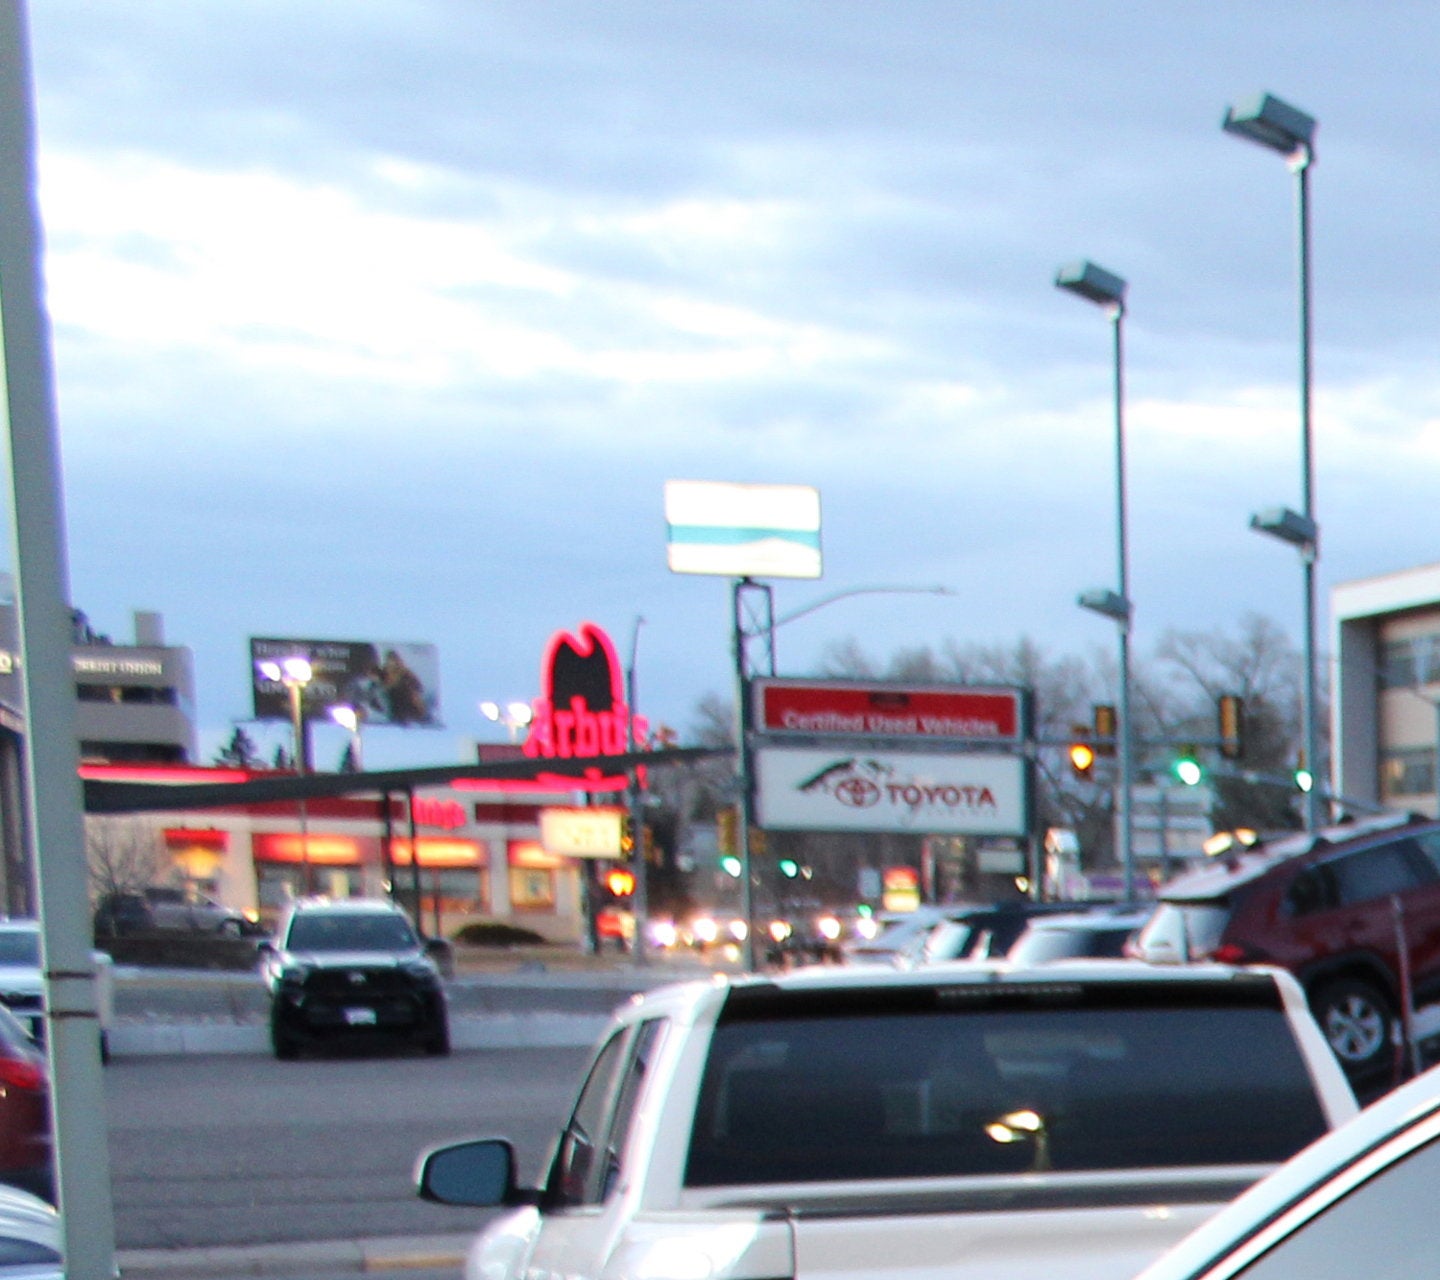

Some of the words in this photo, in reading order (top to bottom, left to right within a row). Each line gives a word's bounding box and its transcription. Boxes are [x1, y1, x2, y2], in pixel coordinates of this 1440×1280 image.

[783, 708, 865, 733] Certified
[868, 713, 918, 735] Used
[922, 715, 999, 736] Vehicles
[885, 783, 998, 808] TOYOTA
